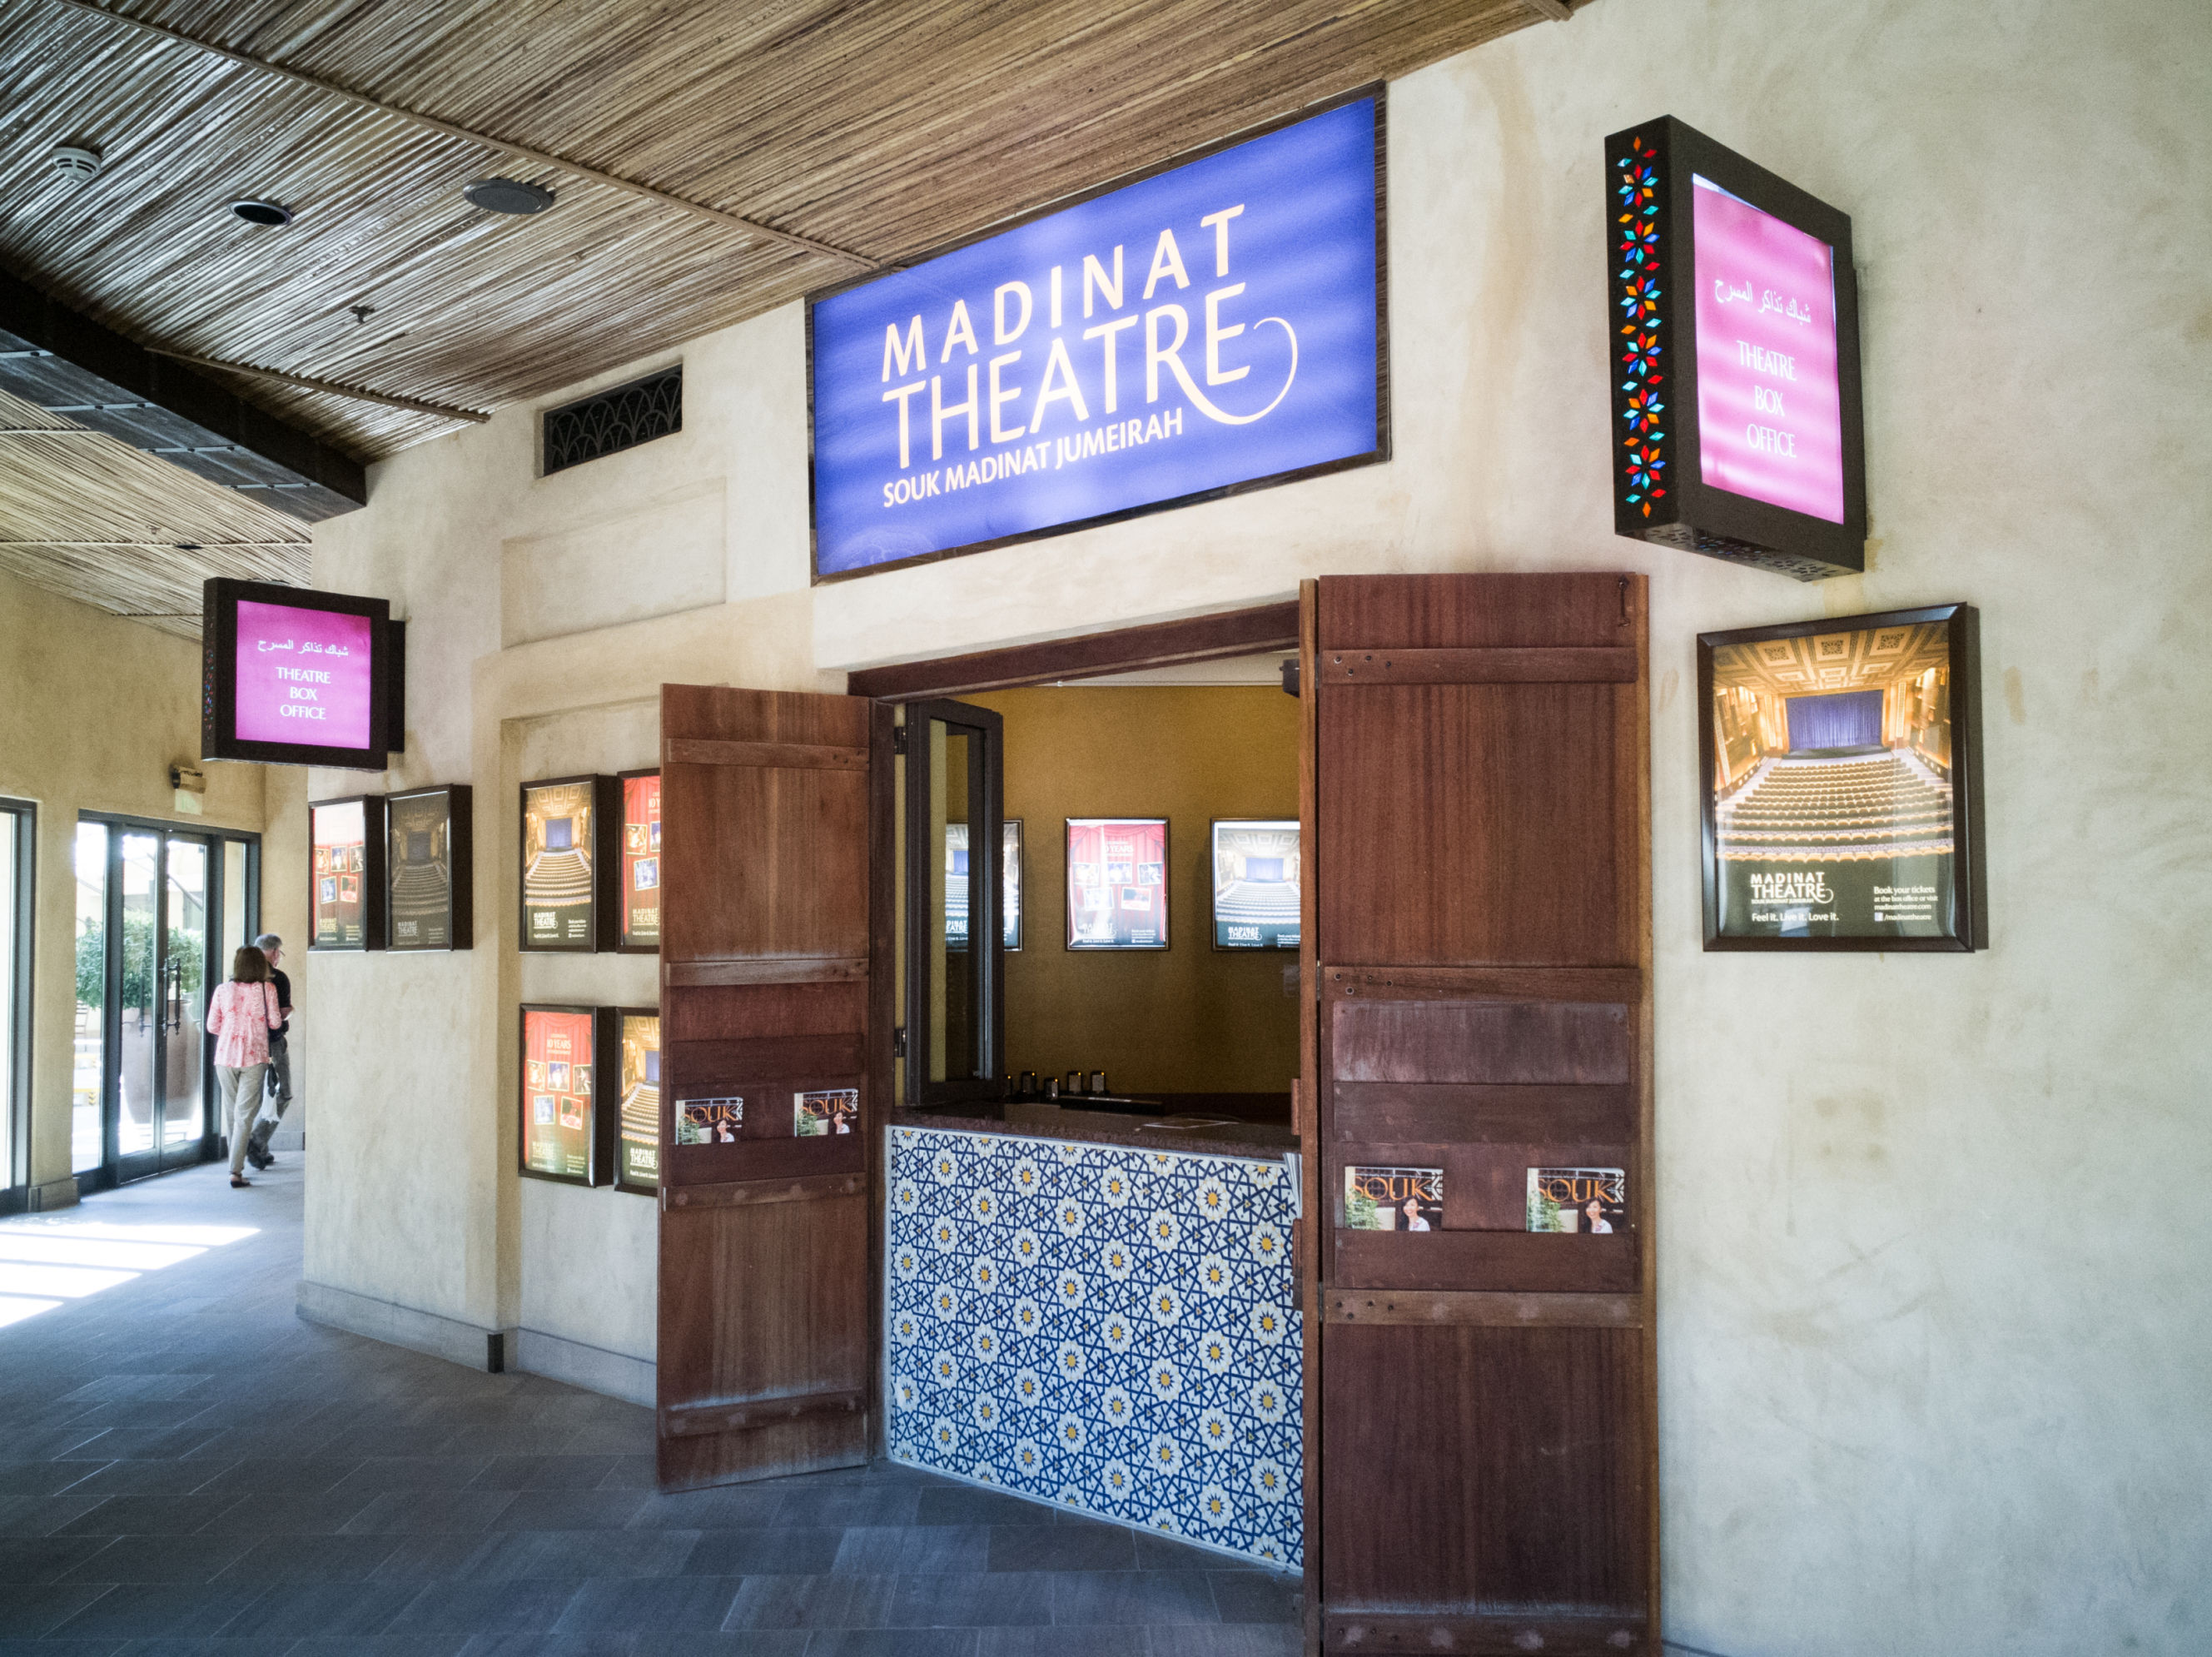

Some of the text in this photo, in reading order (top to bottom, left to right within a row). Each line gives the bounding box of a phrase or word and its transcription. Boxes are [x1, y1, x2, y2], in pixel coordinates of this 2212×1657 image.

[882, 204, 1245, 383] MADINAT
[1714, 277, 1812, 325] شباك تذاكر المسرح
[1736, 339, 1797, 381] THEATRE
[882, 282, 1298, 469] THEATRE
[1754, 386, 1785, 417] BOX
[1747, 423, 1797, 459] OFFICE
[882, 407, 1184, 508] SOUK MADINAT JUMEIRAH
[257, 639, 349, 658] شباك تذاكر المسرح
[275, 666, 331, 684] THEATRE
[290, 686, 318, 701] BOX
[280, 704, 326, 720] OFFICE
[1750, 871, 1826, 884] MADINAT
[1750, 883, 1834, 904] THEATRE
[1873, 885, 1936, 897] Book your tickets
[1752, 913, 1769, 922] Feel
[1770, 913, 1779, 922] it.
[1779, 912, 1797, 922] Live
[1808, 913, 1829, 921] Love
[1830, 912, 1839, 921] it.
[1228, 931, 1263, 940] THEATRE
[1350, 1176, 1433, 1202] SOUK
[1538, 1178, 1616, 1203] SOUK
